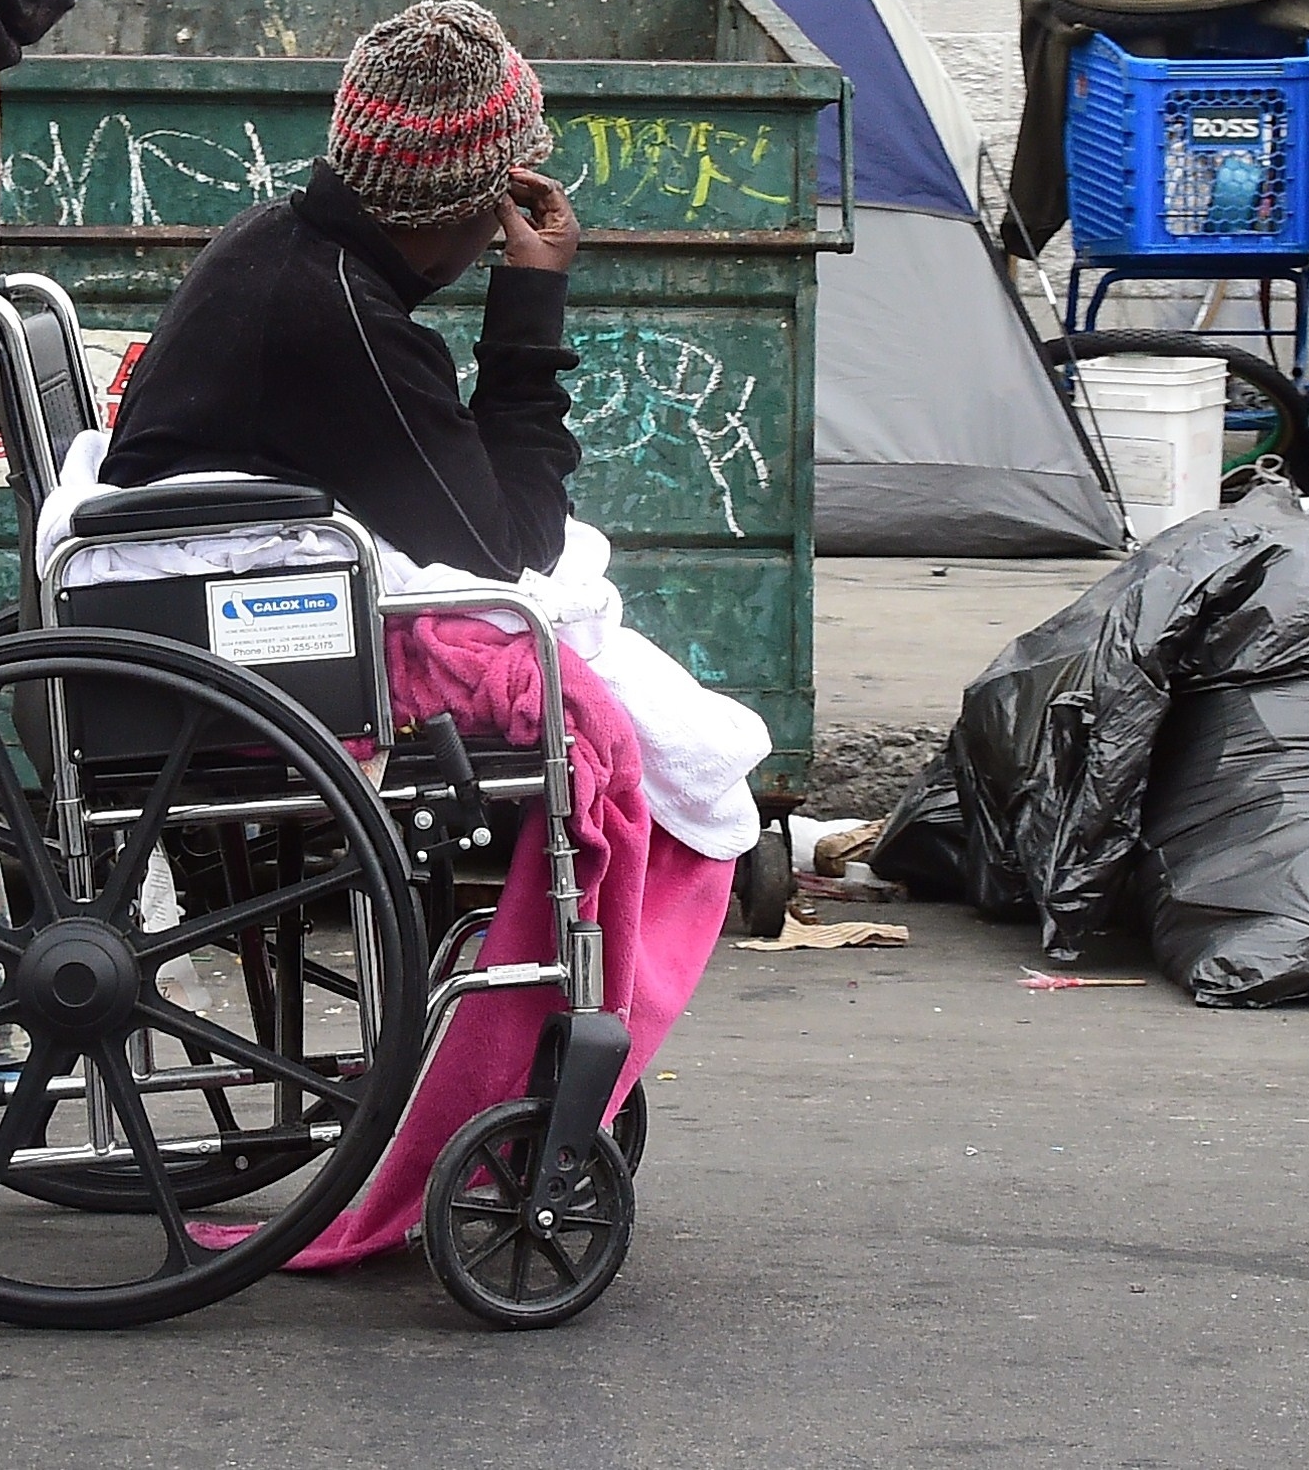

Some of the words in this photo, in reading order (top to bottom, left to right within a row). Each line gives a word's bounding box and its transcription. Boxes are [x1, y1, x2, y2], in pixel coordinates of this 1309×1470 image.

[1192, 117, 1259, 138] ROSS
[252, 600, 300, 613] CALOX
[304, 598, 330, 609] Inc.
[267, 644, 290, 654] (323)
[293, 641, 334, 652] 255-5175
